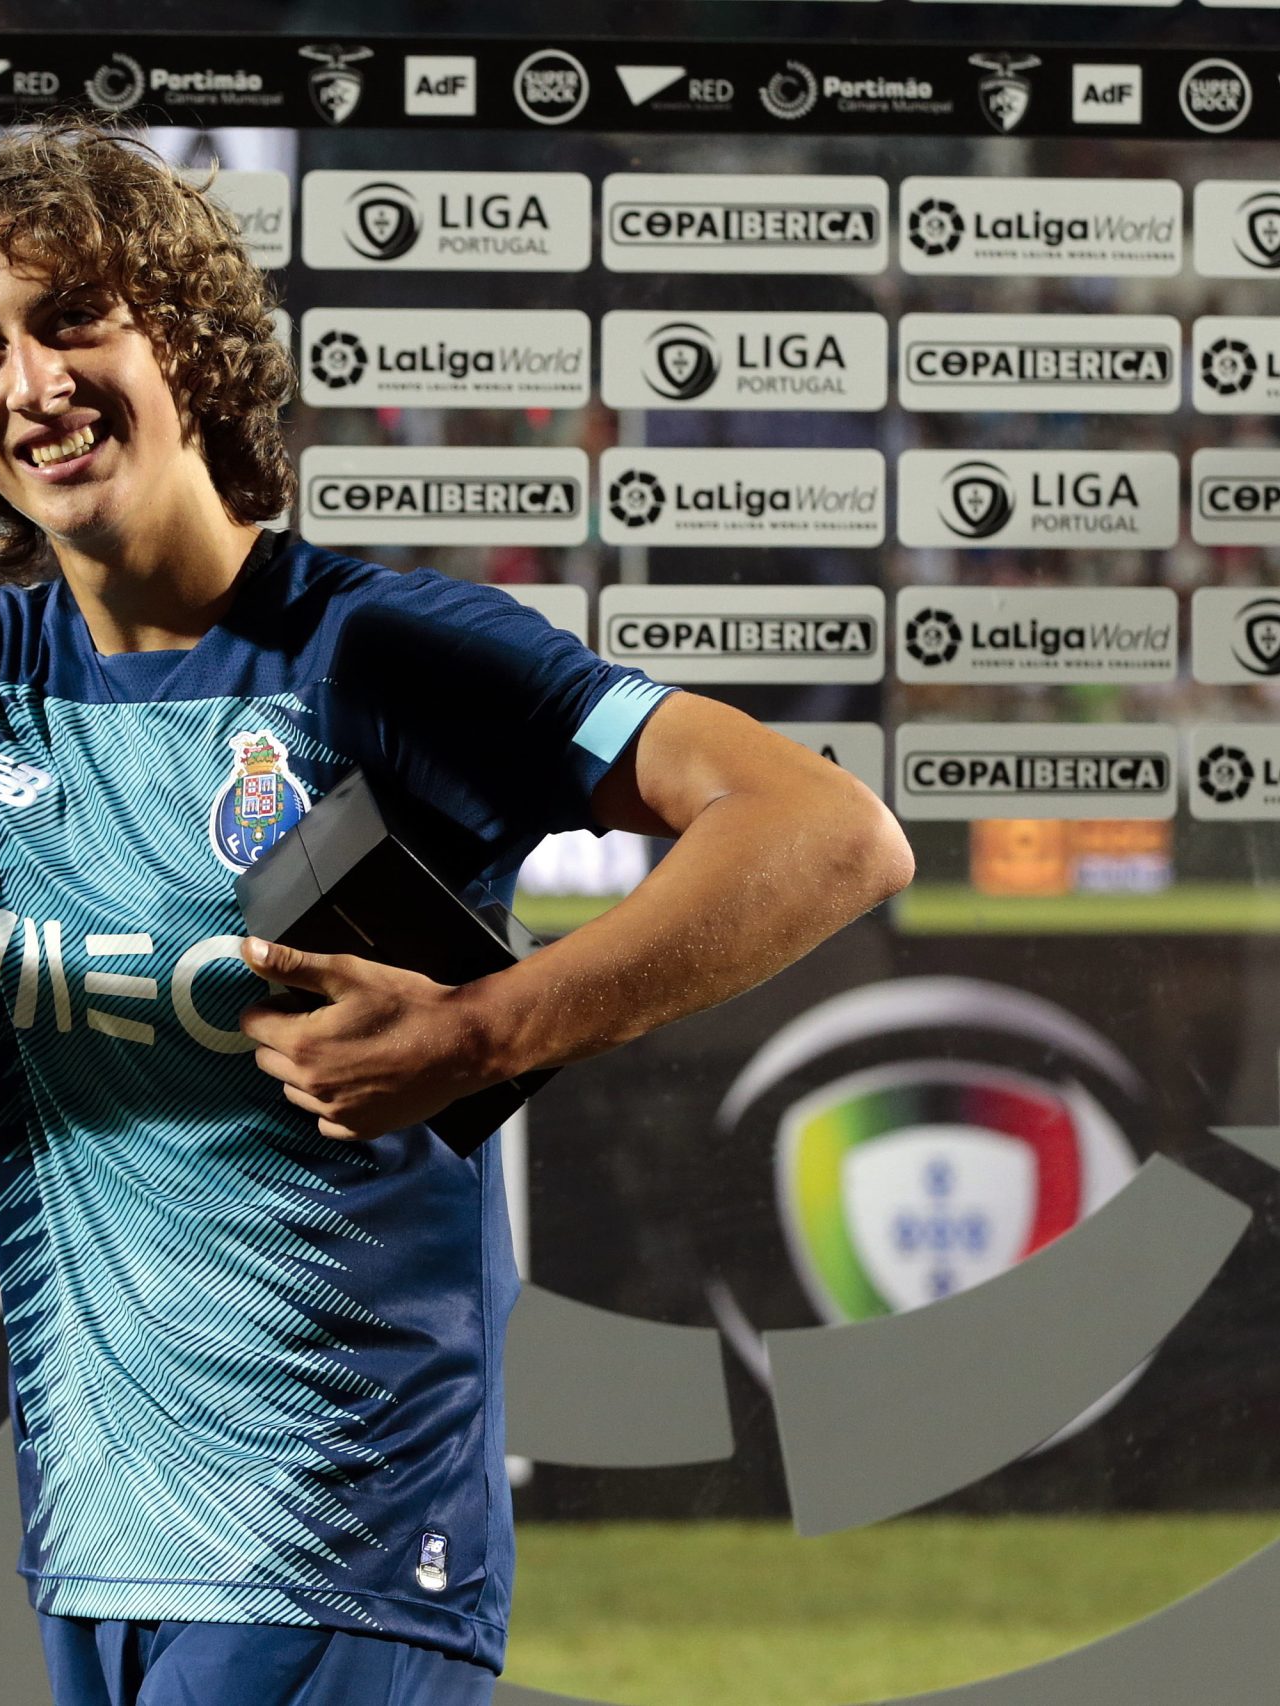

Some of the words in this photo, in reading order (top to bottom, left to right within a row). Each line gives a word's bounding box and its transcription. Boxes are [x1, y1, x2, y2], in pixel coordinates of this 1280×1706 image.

[14, 72, 59, 95] RED
[151, 69, 262, 91] Portimão
[415, 76, 466, 96] AdF
[523, 70, 578, 87] SUPER
[824, 76, 932, 98] Portimão
[1189, 78, 1241, 96] SUPER
[526, 86, 576, 103] BOCK
[689, 79, 734, 102] RED
[1083, 84, 1132, 104] AdF
[1191, 95, 1239, 112] BOCK
[440, 195, 548, 229] LIGA
[439, 236, 549, 255] PORTUGAL
[739, 334, 845, 369] LIGA
[737, 376, 845, 395] PORTUGAL
[1033, 473, 1139, 508] LIGA
[1208, 486, 1280, 512] COP
[1032, 514, 1139, 534] PORTUGAL
